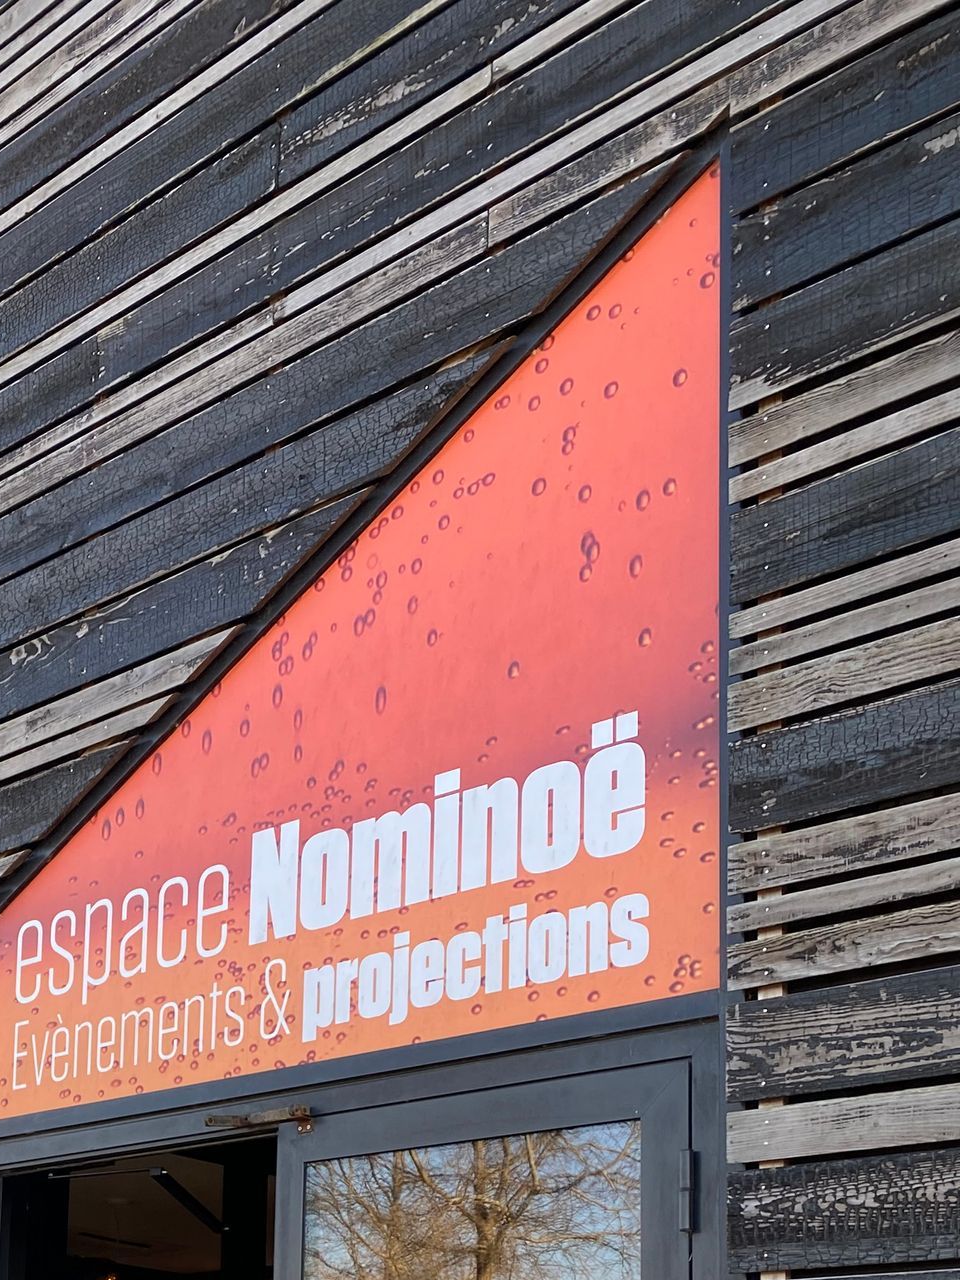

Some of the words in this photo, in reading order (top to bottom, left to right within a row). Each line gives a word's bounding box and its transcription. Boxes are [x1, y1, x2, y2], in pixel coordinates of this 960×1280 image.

[14, 863, 230, 1005] espace
[248, 711, 646, 946] Nominoë
[11, 979, 246, 1090] Evènements
[258, 957, 294, 1043] &
[301, 893, 650, 1043] projections
